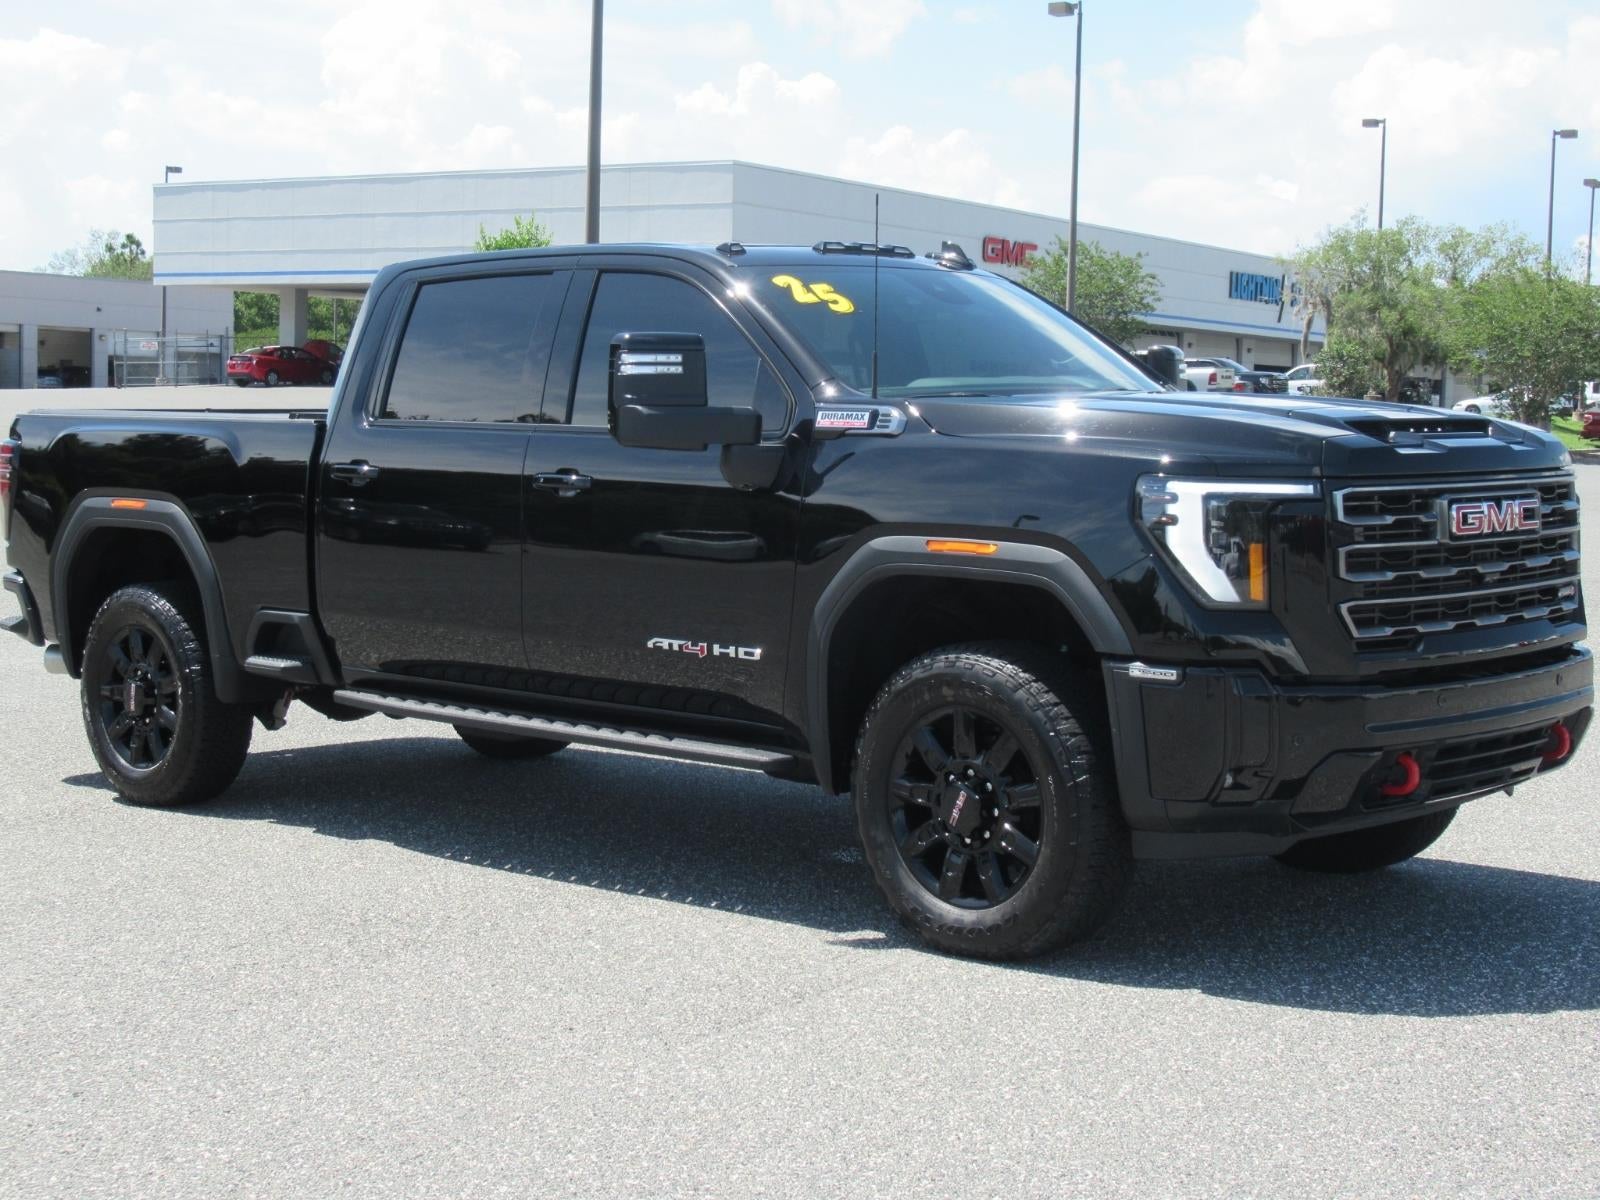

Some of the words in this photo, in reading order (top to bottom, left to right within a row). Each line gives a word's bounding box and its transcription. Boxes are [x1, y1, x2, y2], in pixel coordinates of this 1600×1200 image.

[982, 236, 1038, 268] GMC
[772, 275, 855, 313] 25
[820, 412, 866, 421] DURAMAX
[1451, 499, 1540, 535] GMC
[647, 637, 708, 658] AT4
[713, 643, 762, 660] HD
